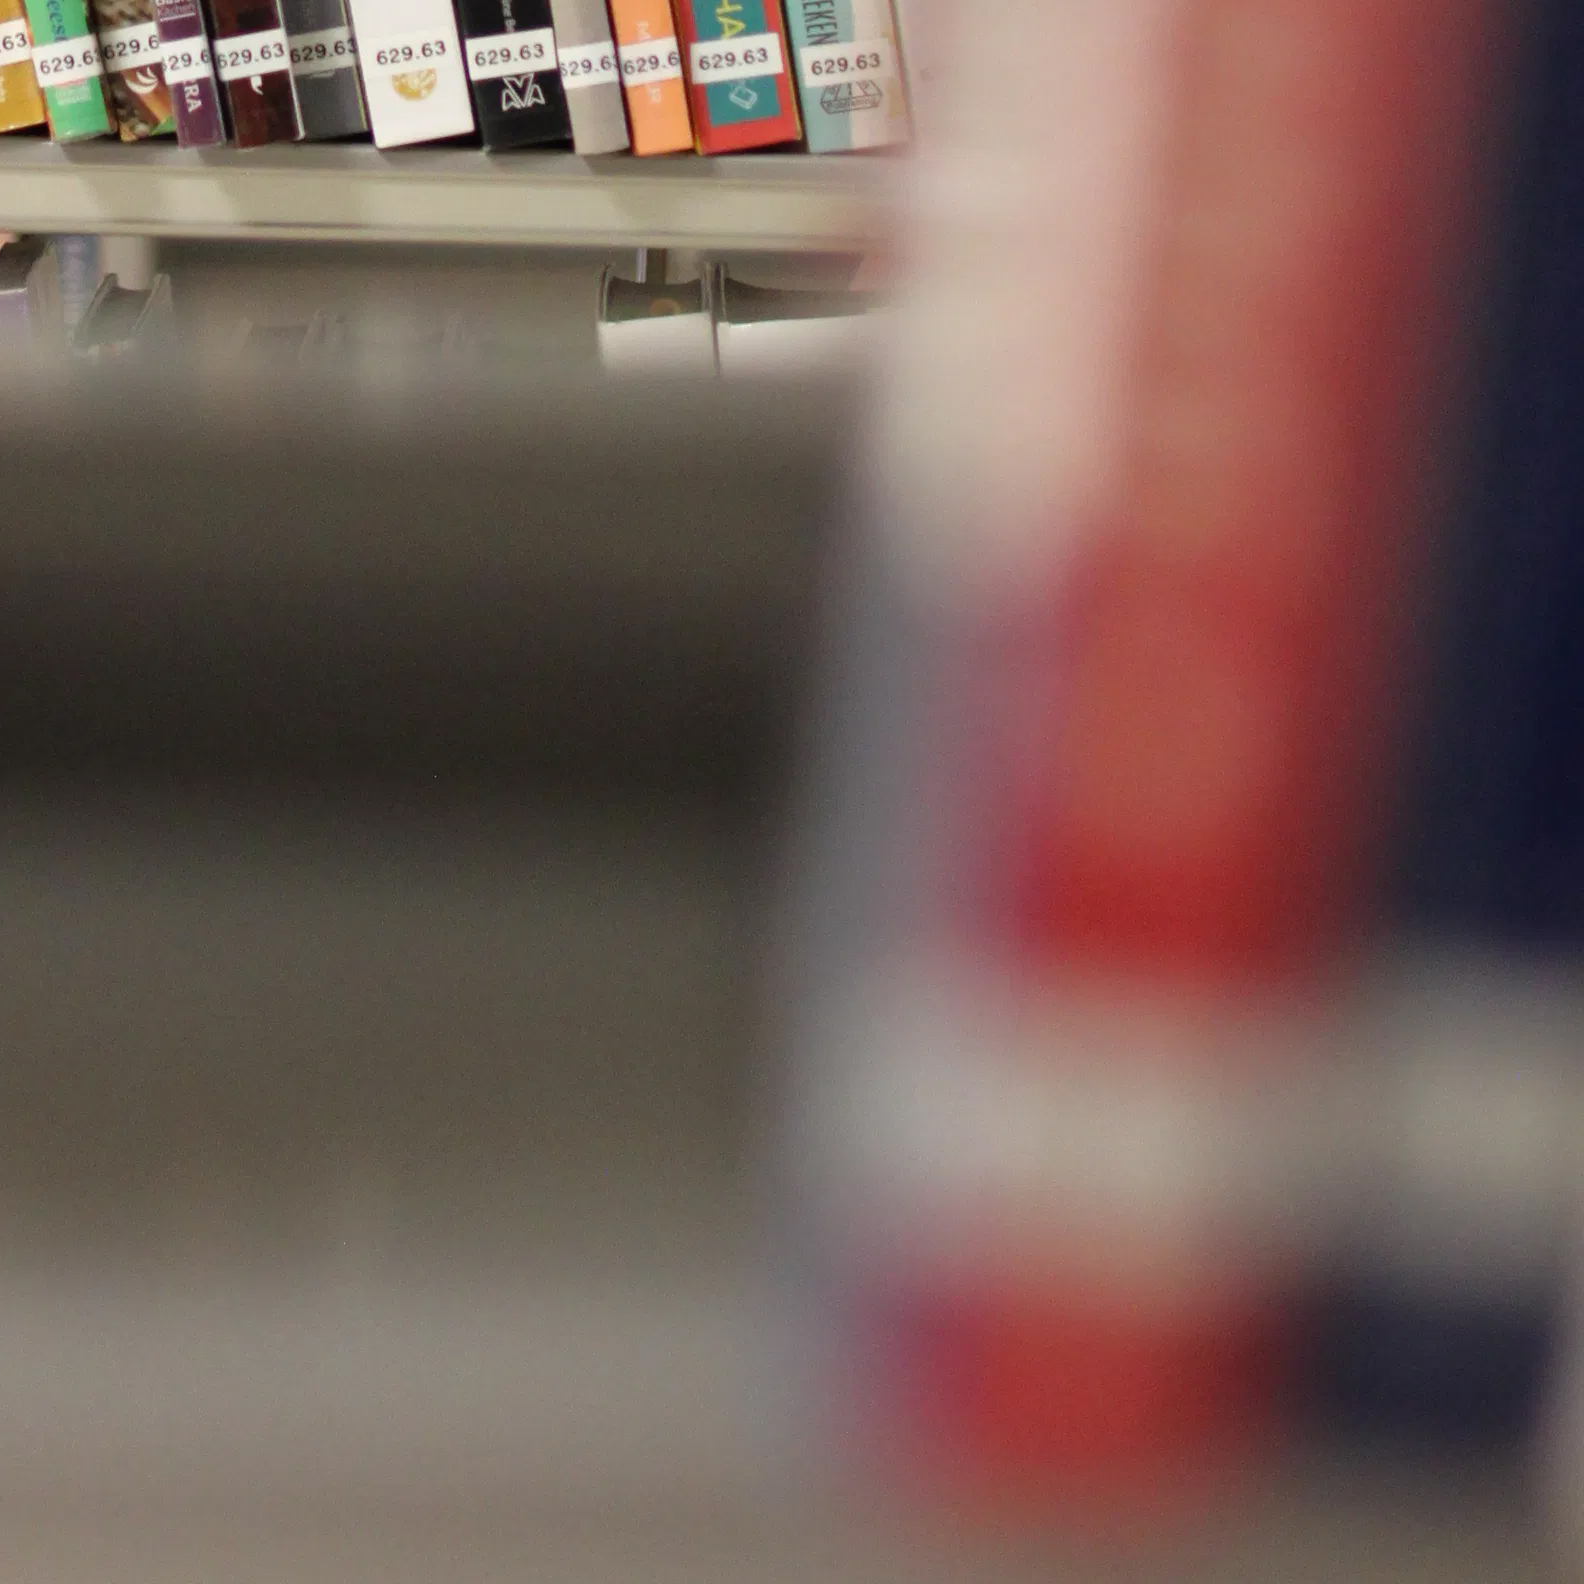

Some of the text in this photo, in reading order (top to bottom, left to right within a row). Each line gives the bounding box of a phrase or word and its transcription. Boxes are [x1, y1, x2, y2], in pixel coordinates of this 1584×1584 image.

[376, 39, 447, 66] 629.63
[475, 42, 546, 69] 629.63
[698, 47, 769, 72] 629.63
[810, 52, 882, 77] 629.63
